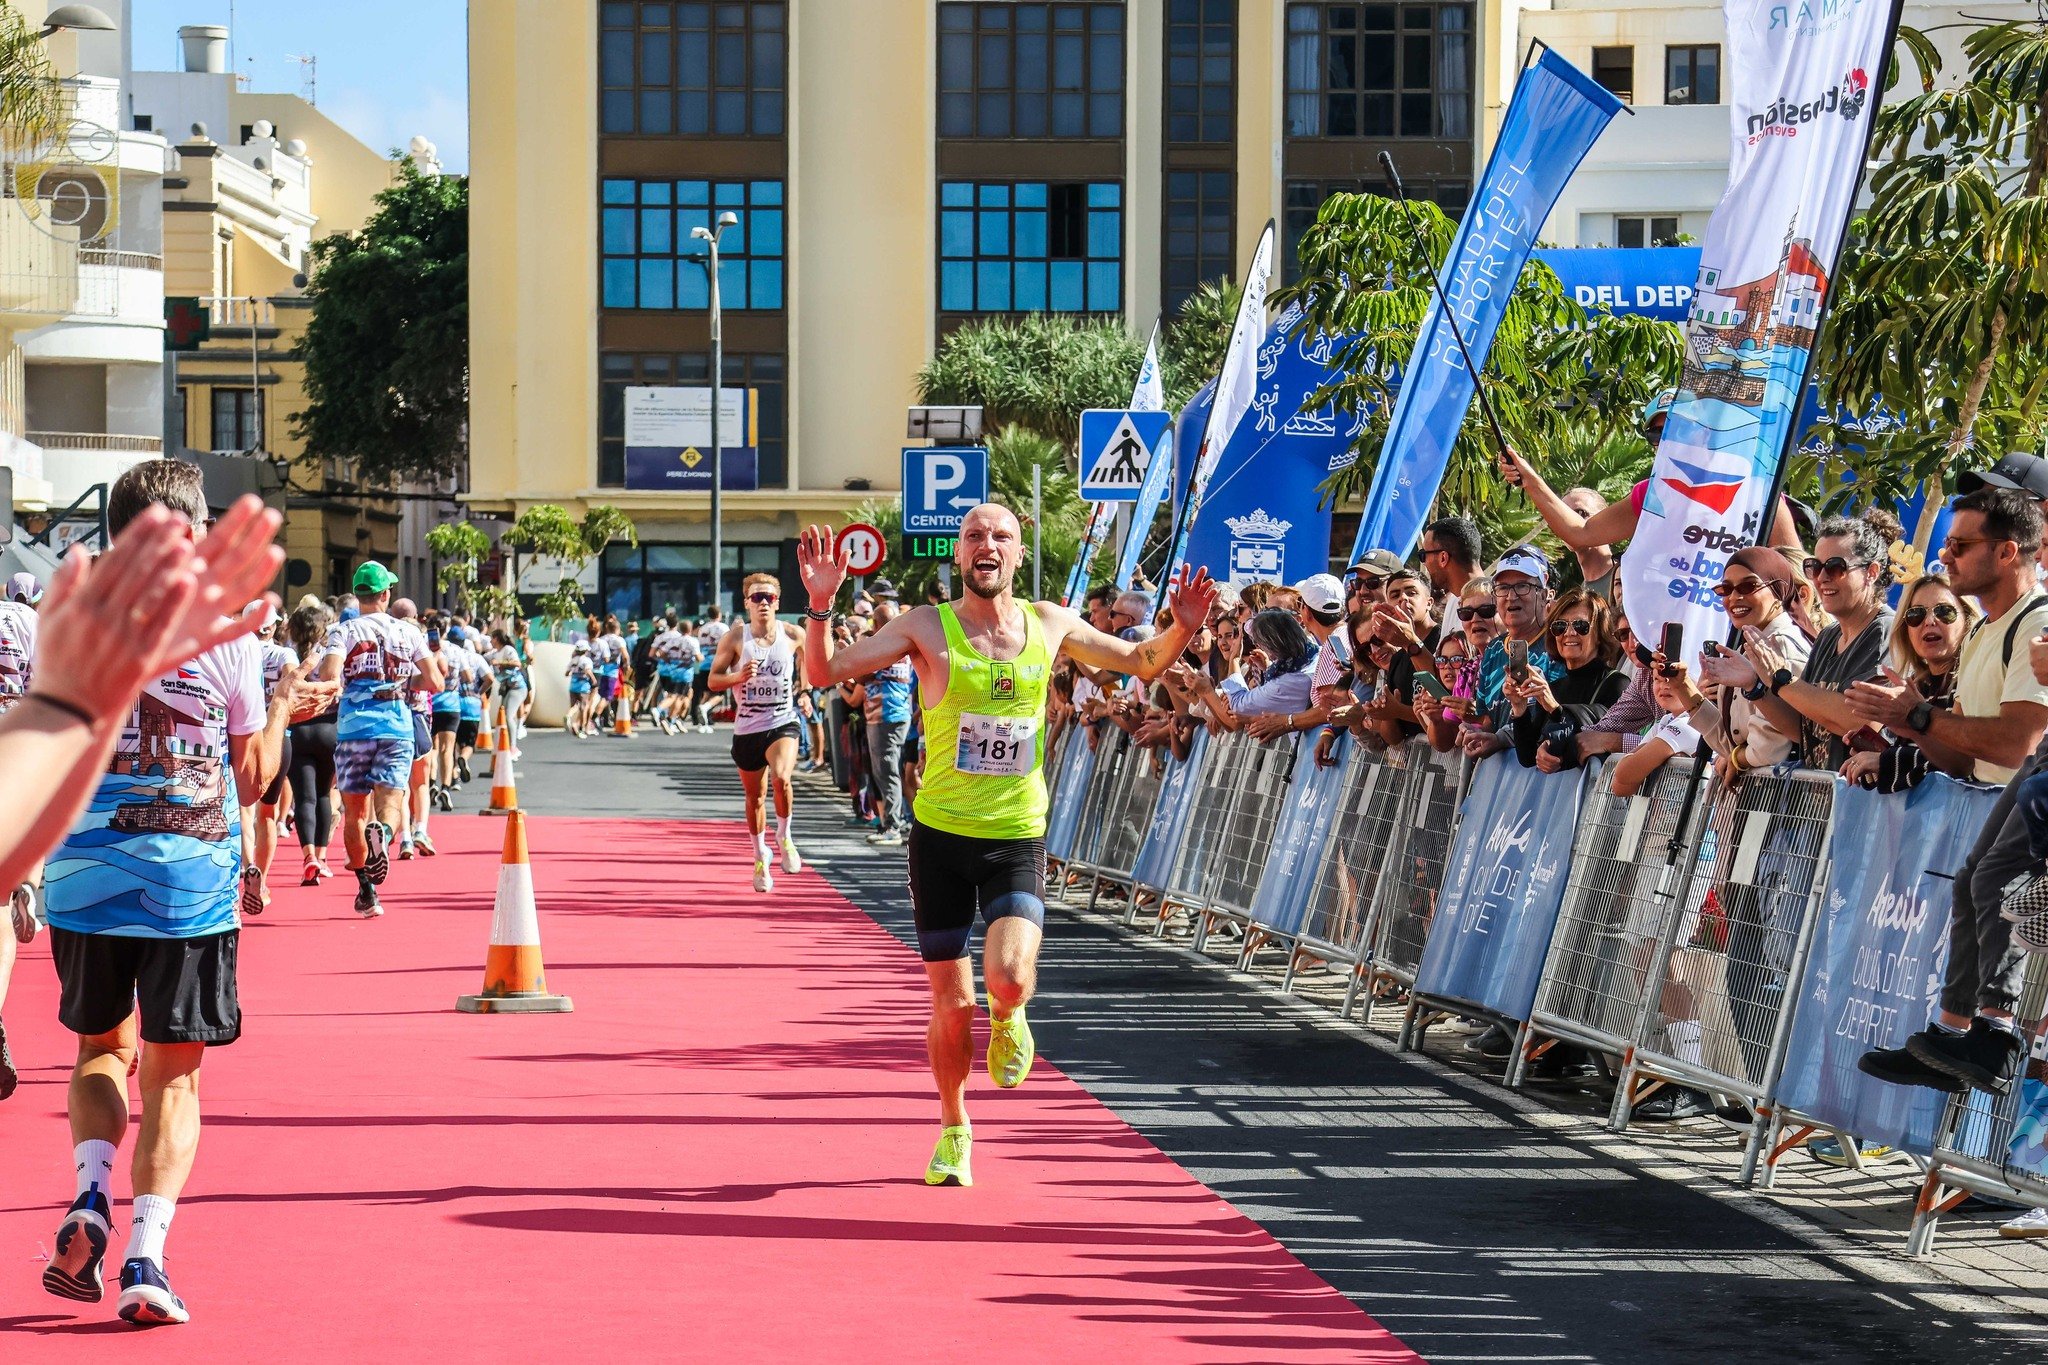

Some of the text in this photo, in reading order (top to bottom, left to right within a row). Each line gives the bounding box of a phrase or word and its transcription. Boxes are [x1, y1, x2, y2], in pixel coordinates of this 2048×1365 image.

[1484, 158, 1533, 221] DEL
[1442, 208, 1526, 371] DEPORTE
[1575, 285, 1630, 307] DEL
[924, 454, 967, 511] P
[160, 679, 210, 695] San Silvestre
[163, 687, 182, 695] Ciudad
[752, 687, 778, 697] 1081
[977, 738, 1020, 760] 181
[1895, 956, 1921, 1001] DEL
[1835, 996, 1898, 1050] DEPORTE
